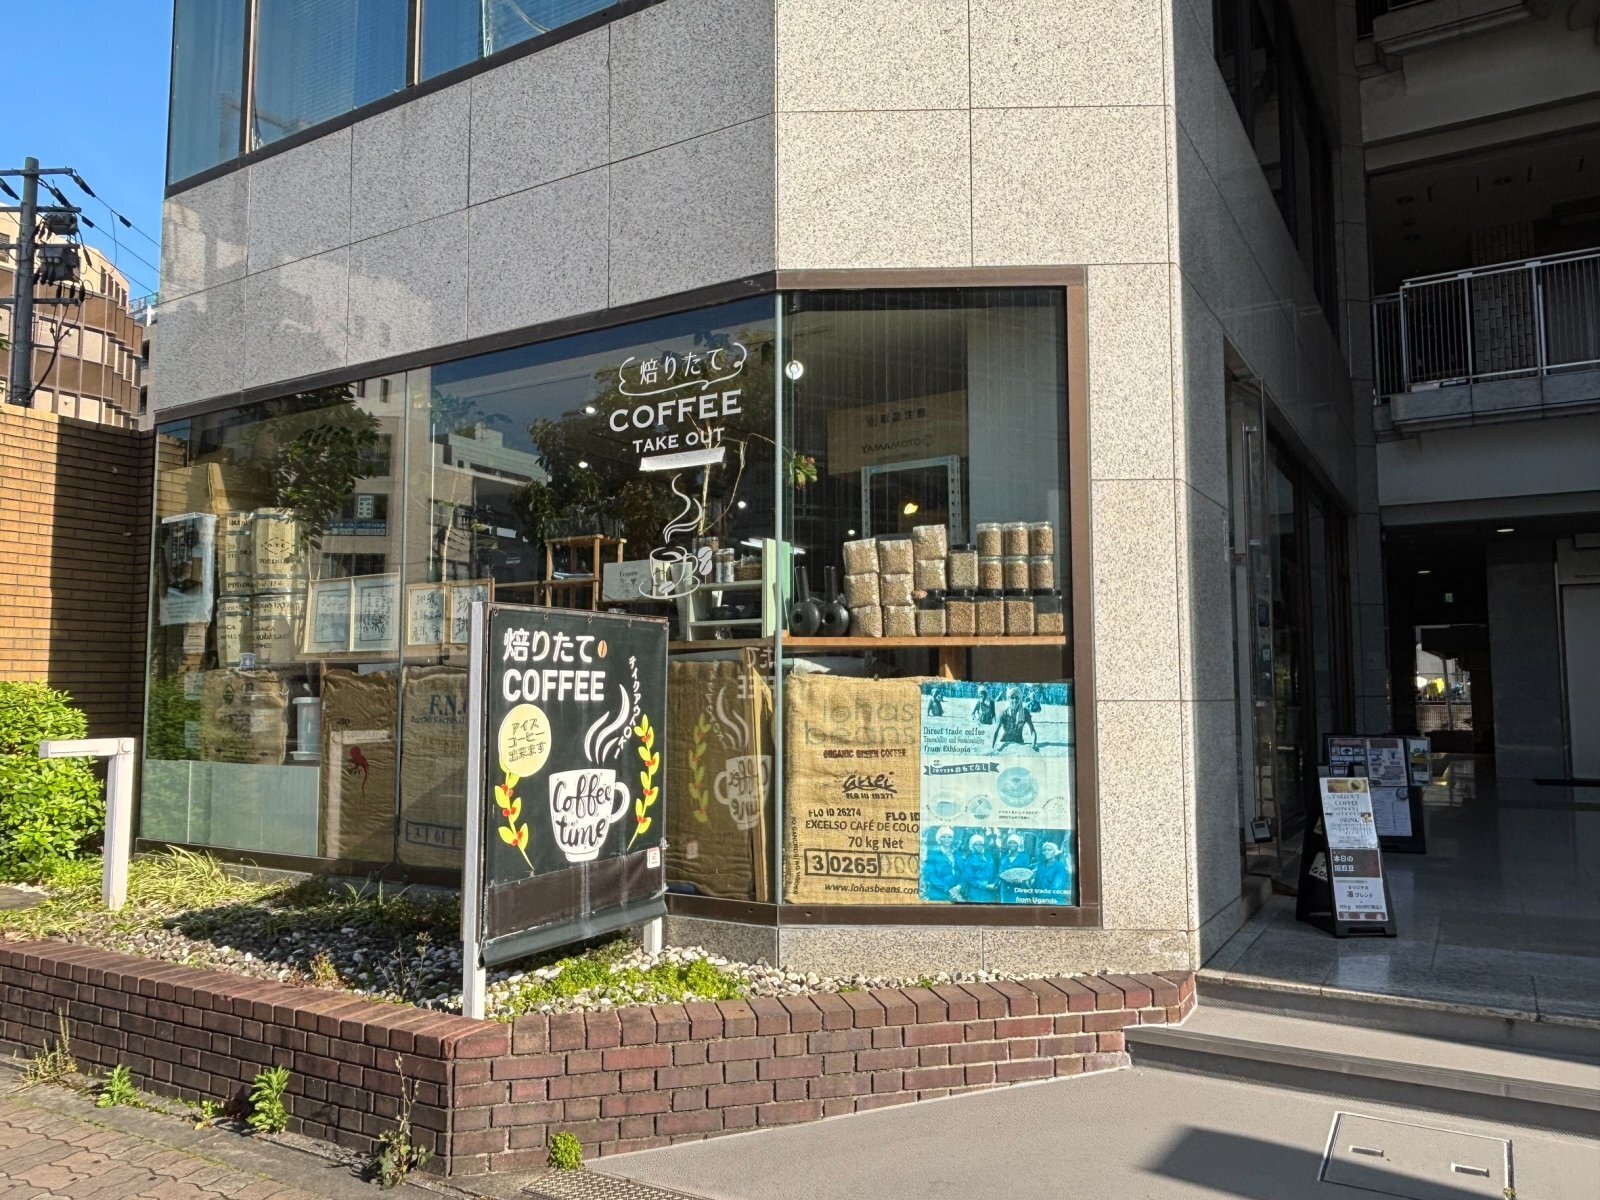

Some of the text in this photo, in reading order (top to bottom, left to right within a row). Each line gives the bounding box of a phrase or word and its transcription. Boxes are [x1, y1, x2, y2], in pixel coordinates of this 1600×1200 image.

[640, 347, 724, 385] 焙りたて
[609, 388, 742, 432] COFFEE
[632, 426, 725, 454] TAKE OUT
[503, 627, 596, 663] 焙りたて
[502, 668, 606, 702] COFFEE
[507, 731, 546, 749] コーヒー
[923, 726, 986, 736] Direct trade coffee
[923, 744, 971, 754] from Ethiopia
[553, 774, 612, 819] Coffee
[808, 808, 862, 818] FLO ID 26274
[885, 812, 907, 822] FLO
[555, 816, 606, 847] time
[805, 820, 848, 831] EXCELSO
[850, 819, 875, 832] CAFÉ
[877, 822, 891, 832] DE
[848, 836, 904, 851] 70 kg Net
[812, 854, 825, 872] 3
[829, 855, 878, 874] 0265
